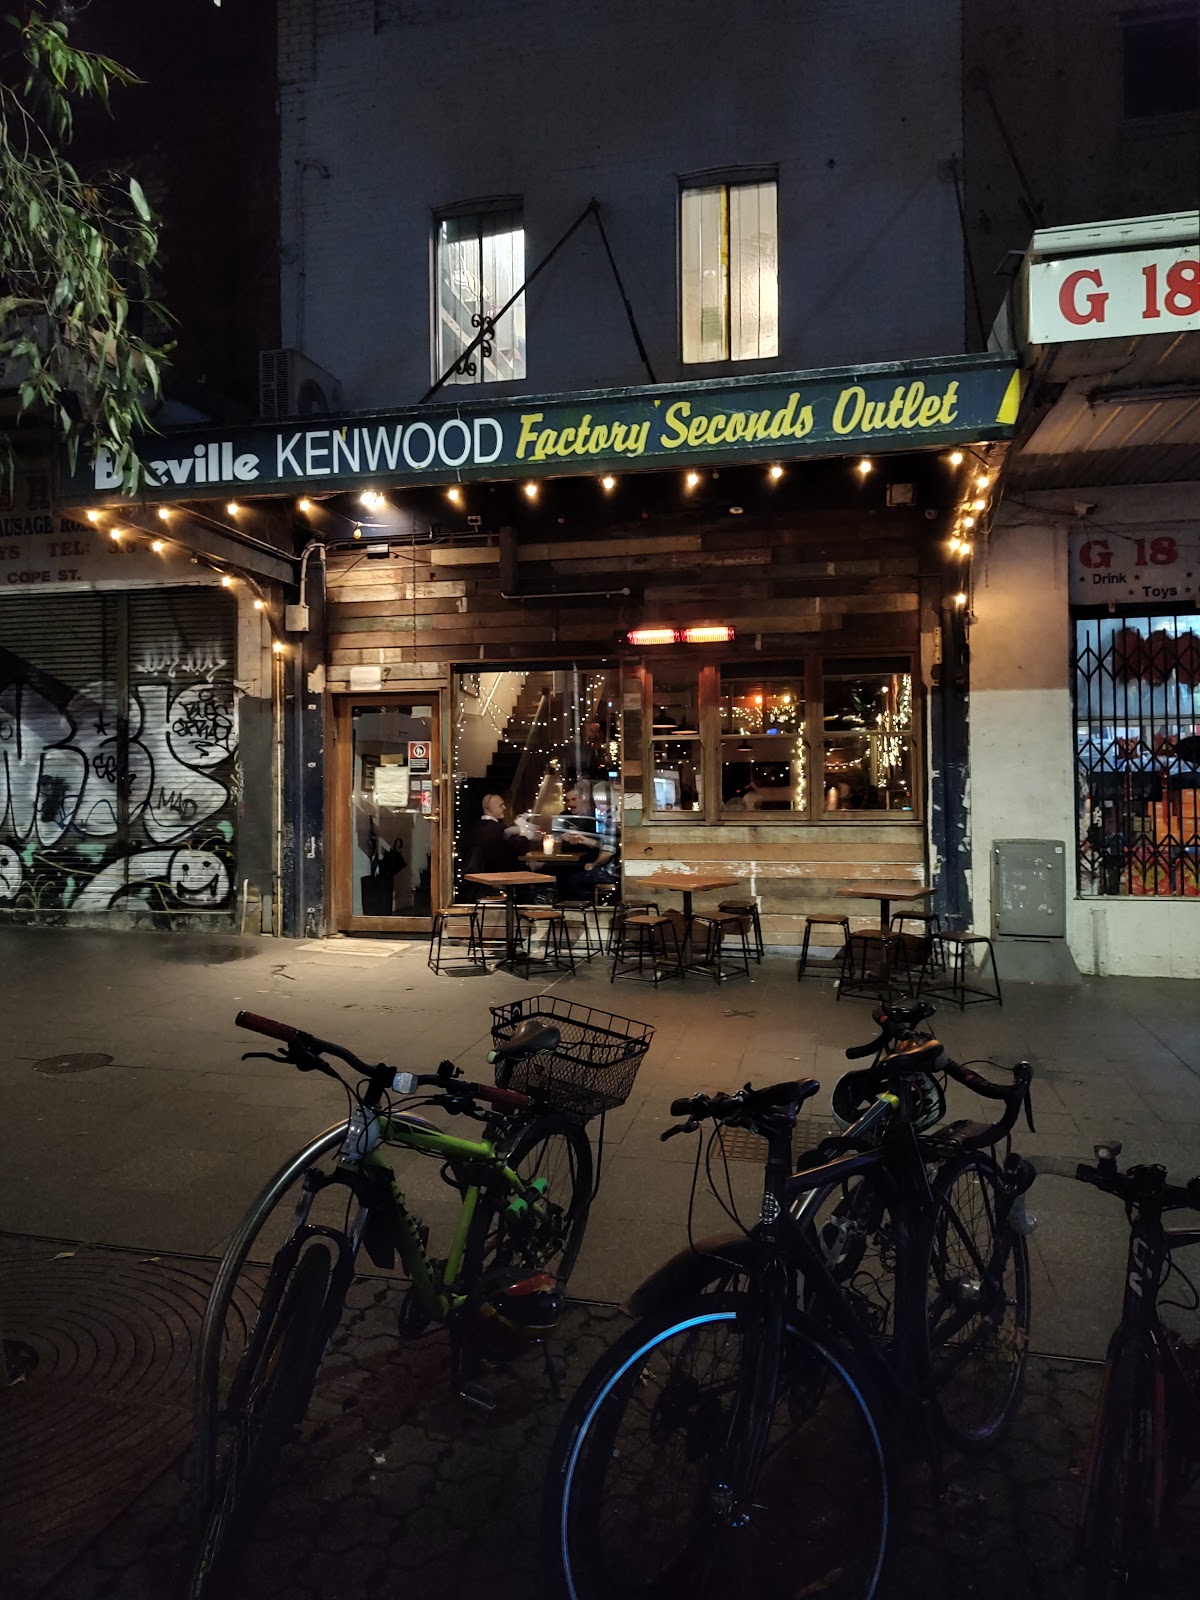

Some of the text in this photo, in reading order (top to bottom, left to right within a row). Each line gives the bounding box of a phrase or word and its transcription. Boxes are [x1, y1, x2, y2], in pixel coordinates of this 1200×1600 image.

[1059, 260, 1200, 325] G 18
[94, 380, 960, 490] Beville KENWOOD Factory Seconds Outlet
[1079, 536, 1178, 569] G 18
[7, 569, 81, 584] COPE ST.
[1093, 573, 1127, 584] Drink
[1142, 586, 1178, 598] Toys
